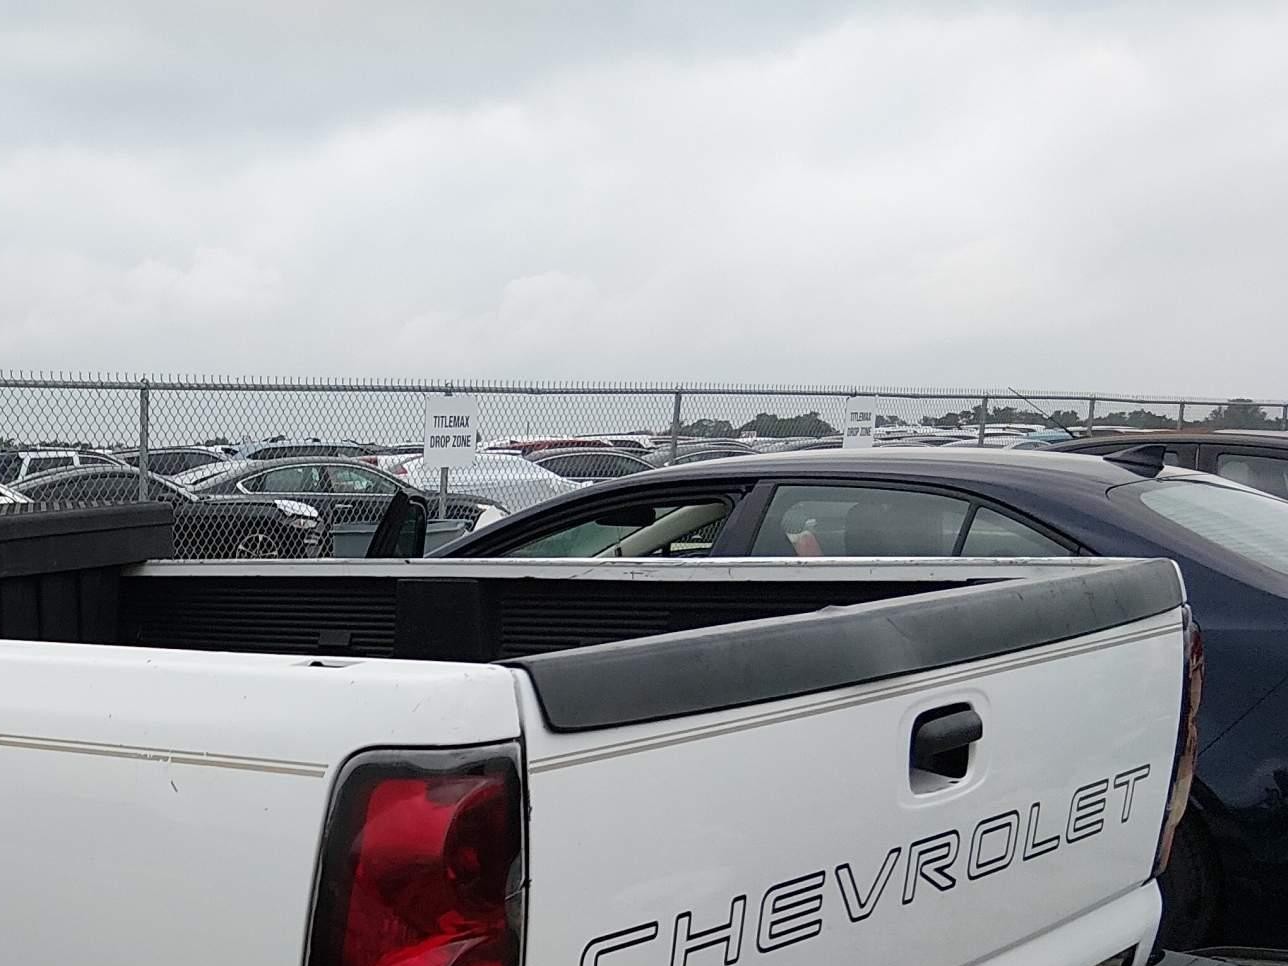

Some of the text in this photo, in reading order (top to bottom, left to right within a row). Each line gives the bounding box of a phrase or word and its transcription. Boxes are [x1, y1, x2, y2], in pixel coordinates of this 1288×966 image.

[433, 415, 470, 428] TITLEMAX
[430, 435, 472, 448] DROP ZONE
